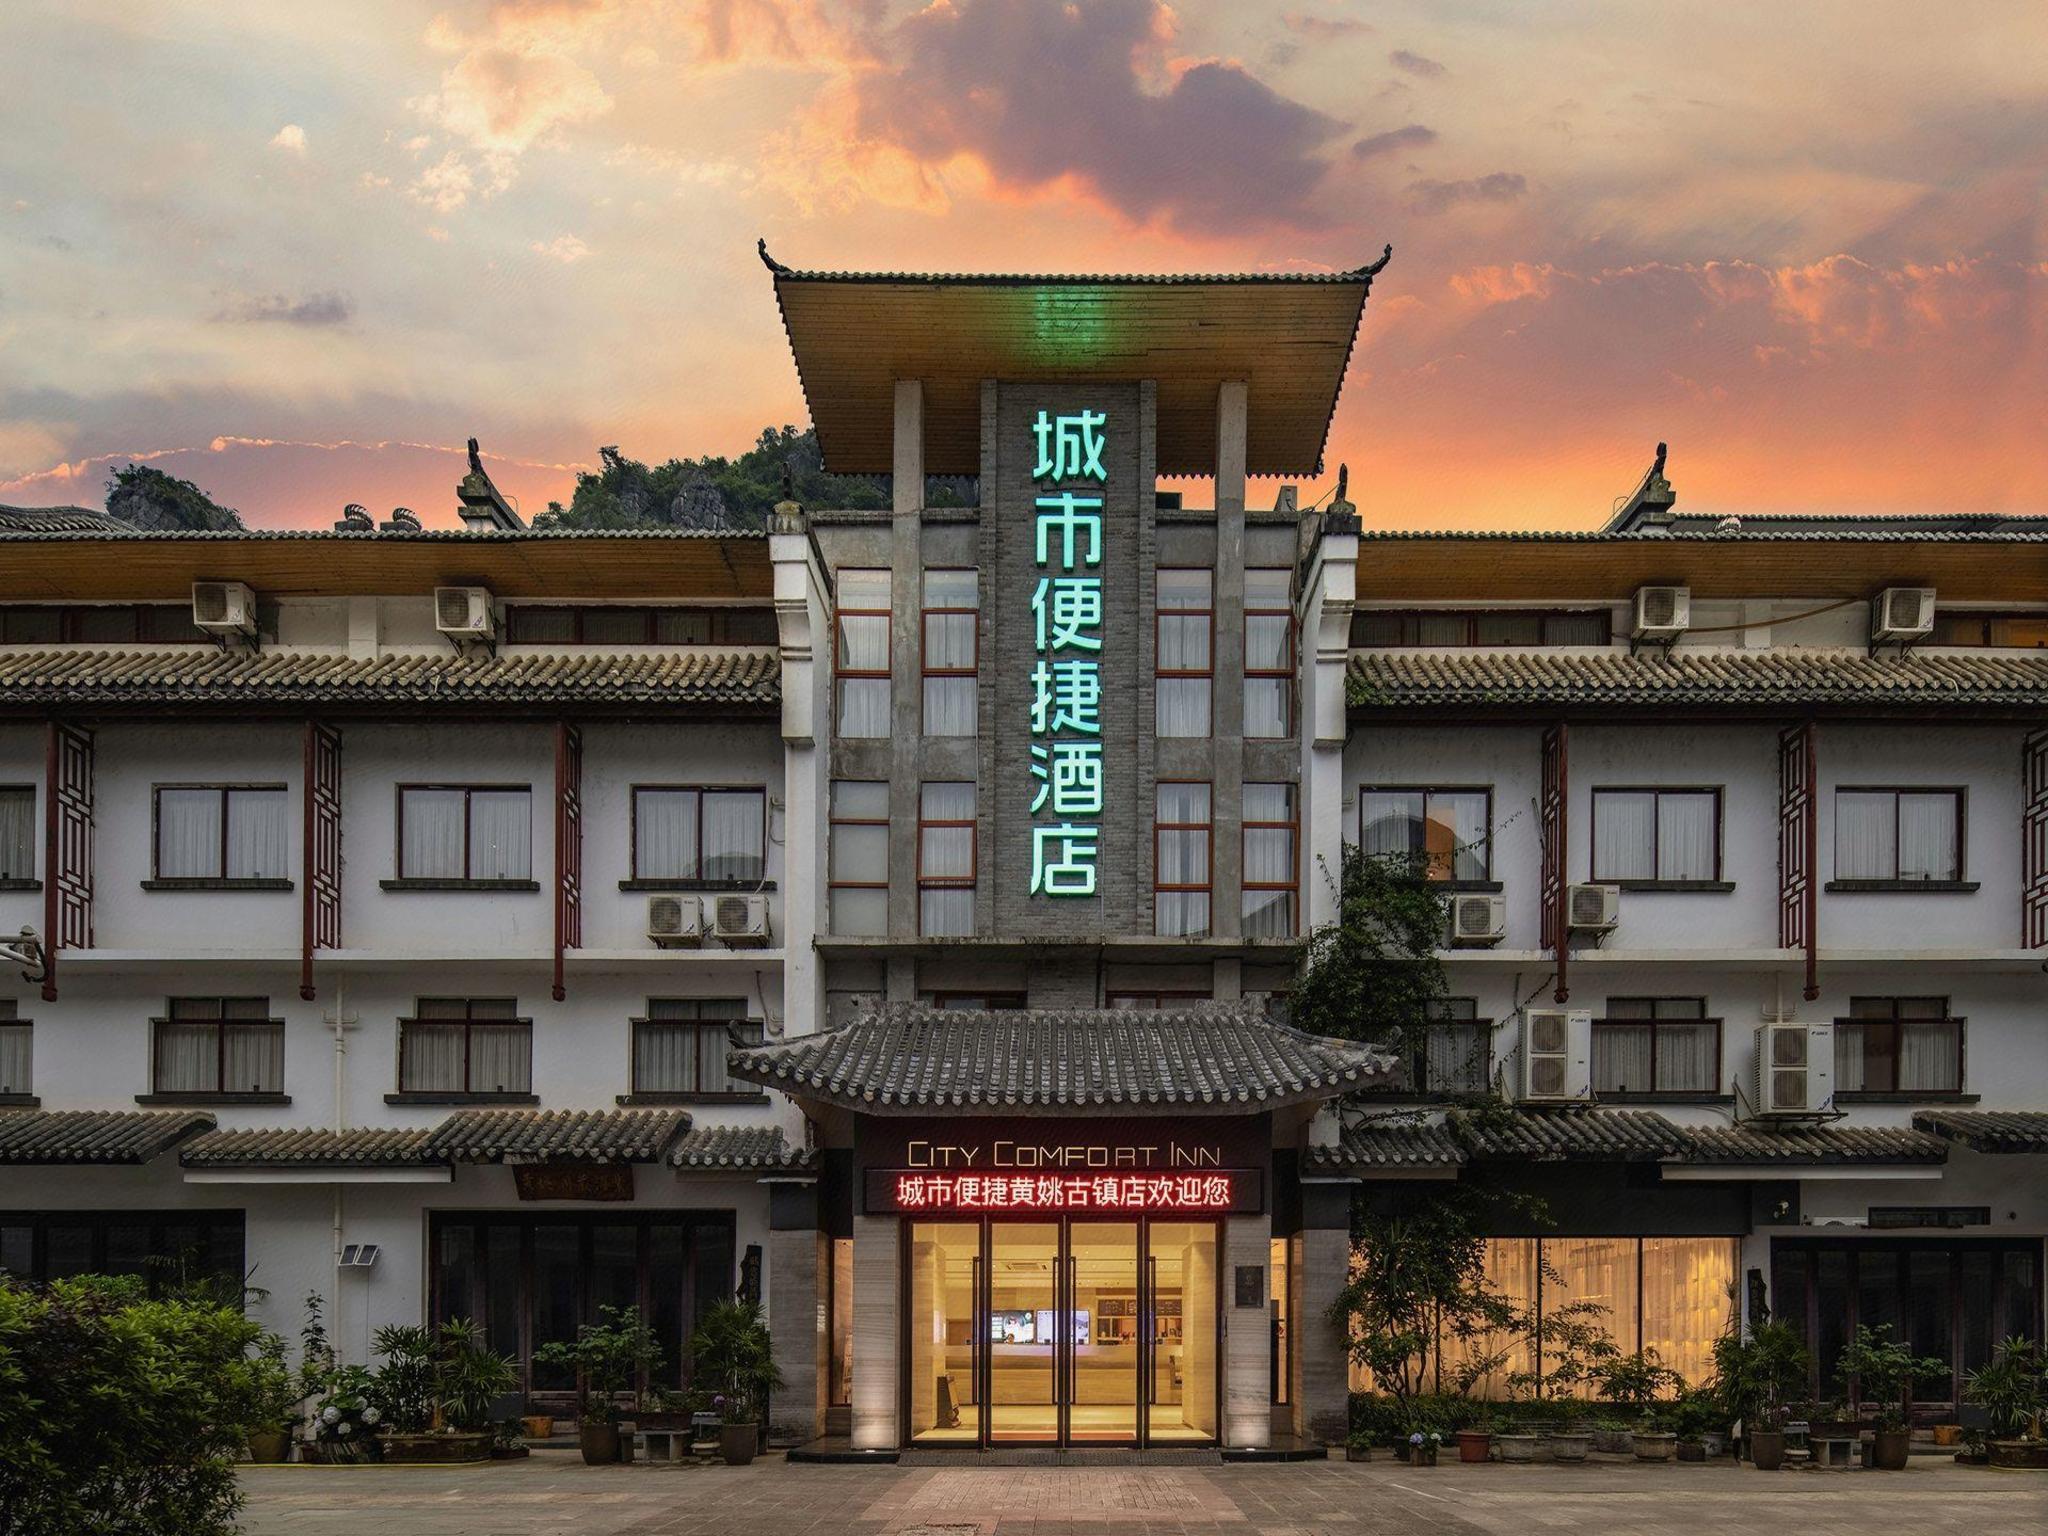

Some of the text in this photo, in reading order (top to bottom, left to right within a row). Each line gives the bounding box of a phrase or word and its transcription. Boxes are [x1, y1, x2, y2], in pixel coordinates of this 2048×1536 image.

[1030, 409, 1107, 897] 城市便捷酒店
[908, 1141, 979, 1167] CITY
[1170, 1141, 1220, 1167] INN
[897, 1176, 1231, 1207] 城市便捷黄姚古镇店欢迎您
